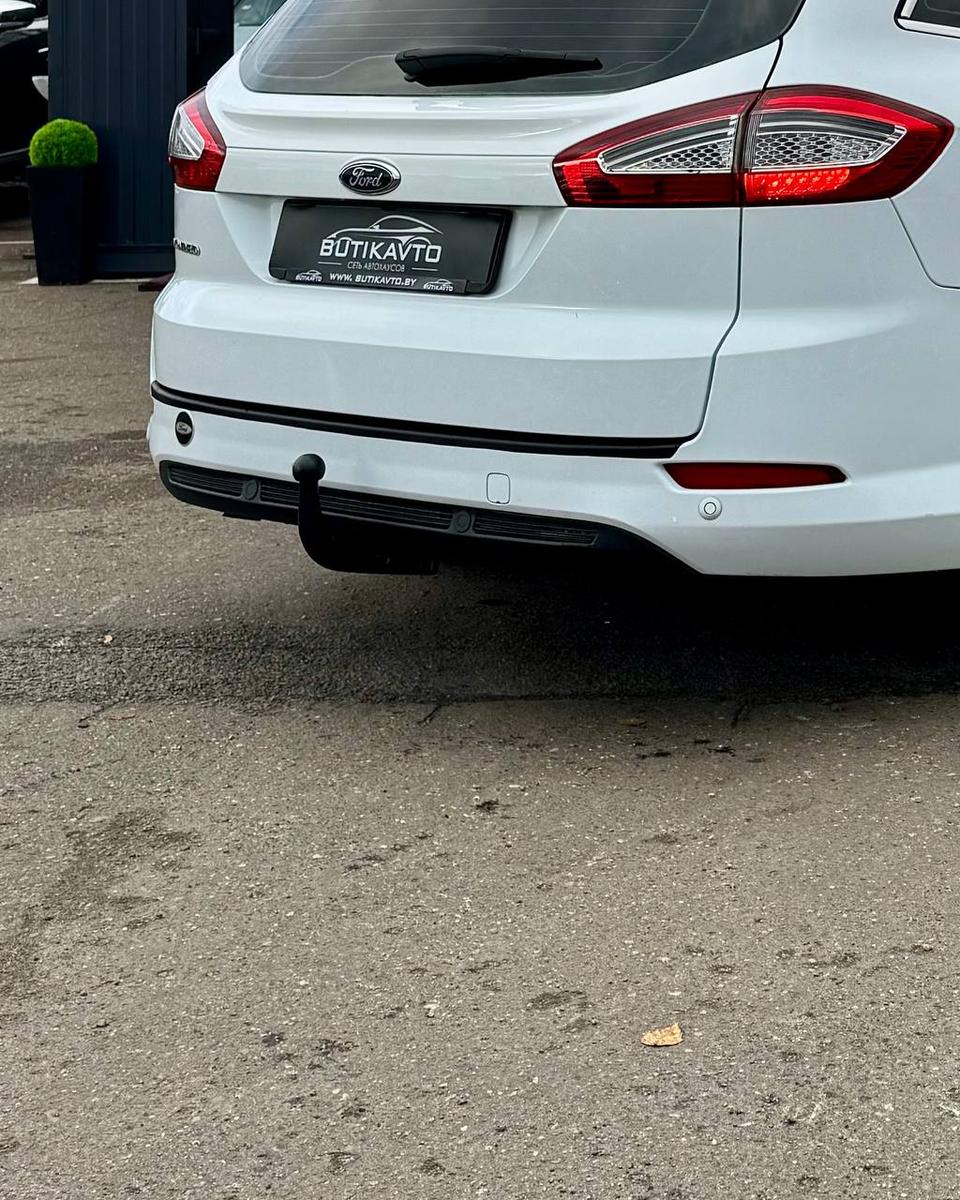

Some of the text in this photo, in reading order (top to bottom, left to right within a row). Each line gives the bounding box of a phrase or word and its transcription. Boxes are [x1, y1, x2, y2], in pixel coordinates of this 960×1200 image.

[350, 167, 383, 186] Ford
[319, 239, 442, 263] BUTIKAVTO
[347, 261, 405, 273] СЕТЬ АВТОХАУСОВ
[329, 273, 417, 286] WWW. BUTIKAVTO.BY
